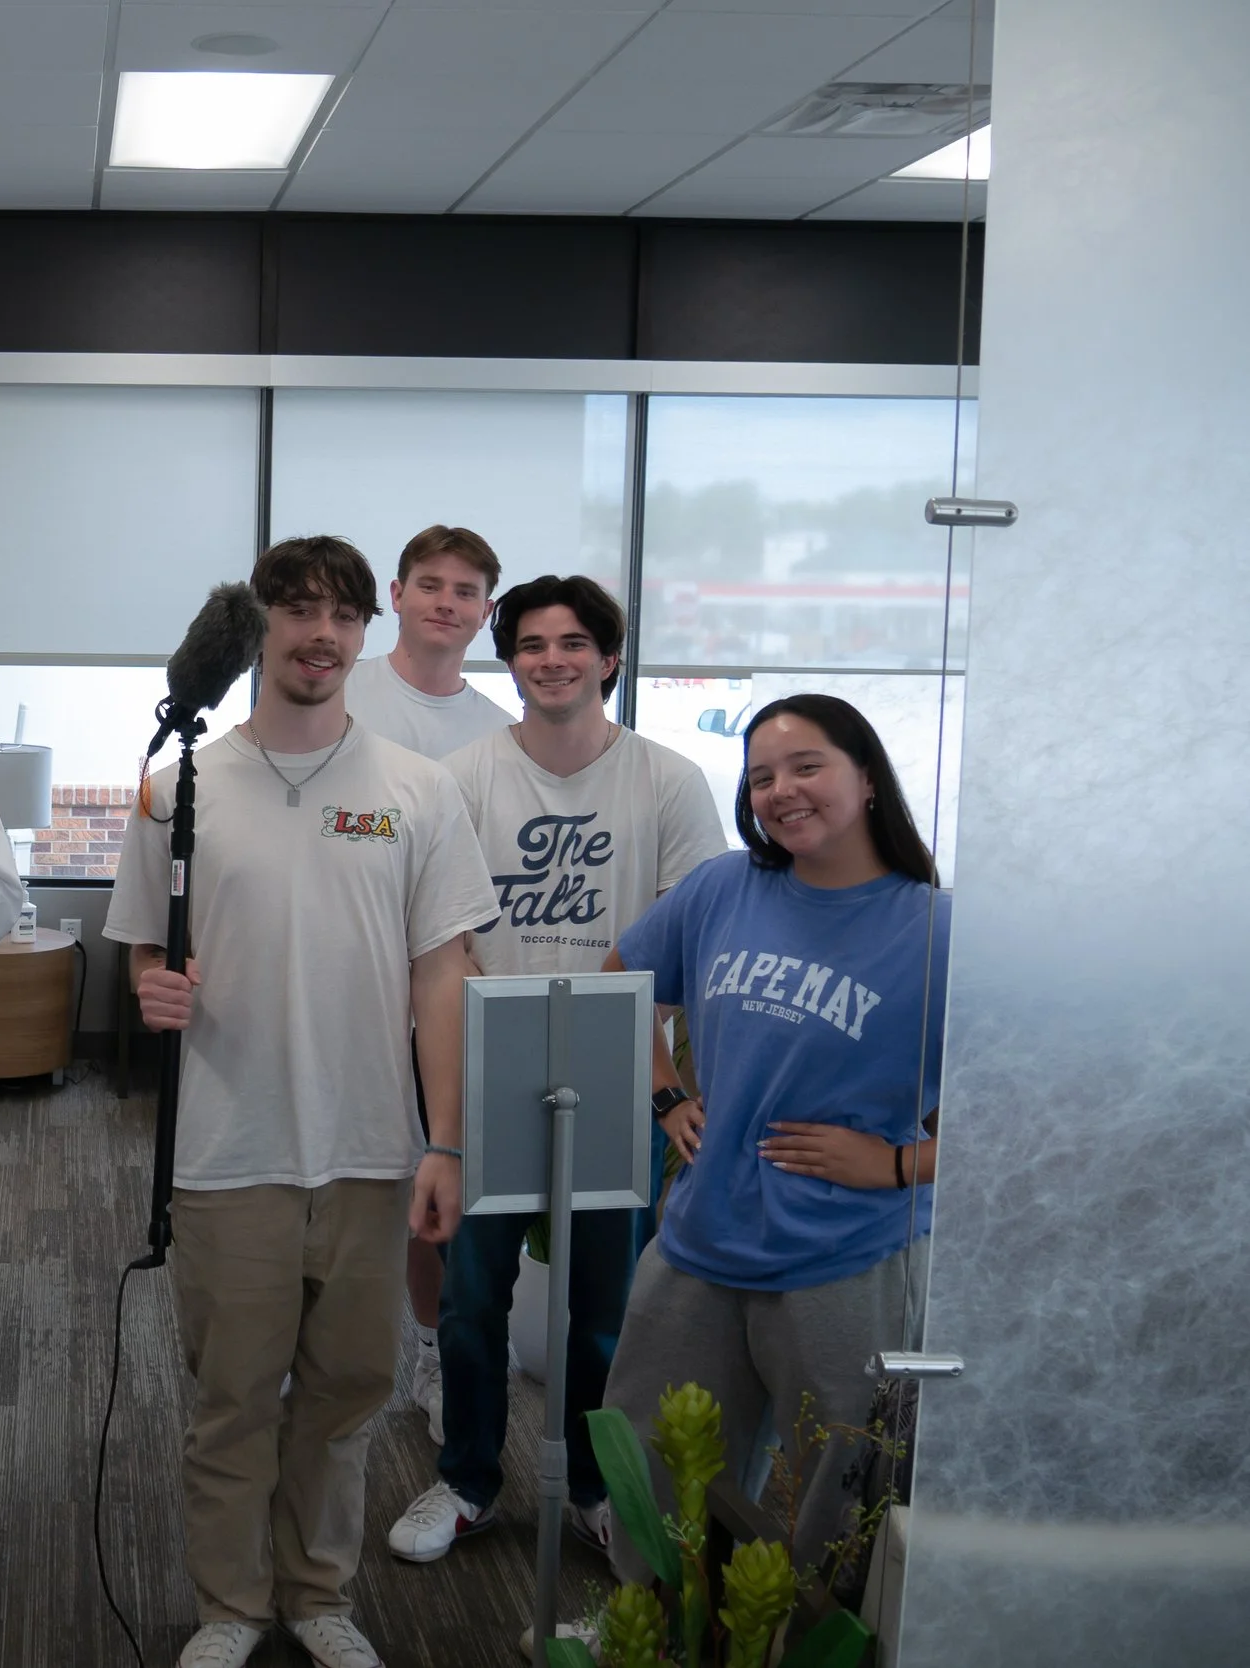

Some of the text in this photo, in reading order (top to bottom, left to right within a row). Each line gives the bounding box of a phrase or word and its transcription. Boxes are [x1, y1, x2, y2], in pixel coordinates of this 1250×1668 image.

[334, 811, 395, 838] LSA
[517, 811, 614, 871] The
[473, 869, 607, 934] Falls
[570, 937, 612, 949] COLLEGE
[704, 950, 882, 1042] CAPE MAY
[742, 999, 806, 1025] NEW JERSEY
